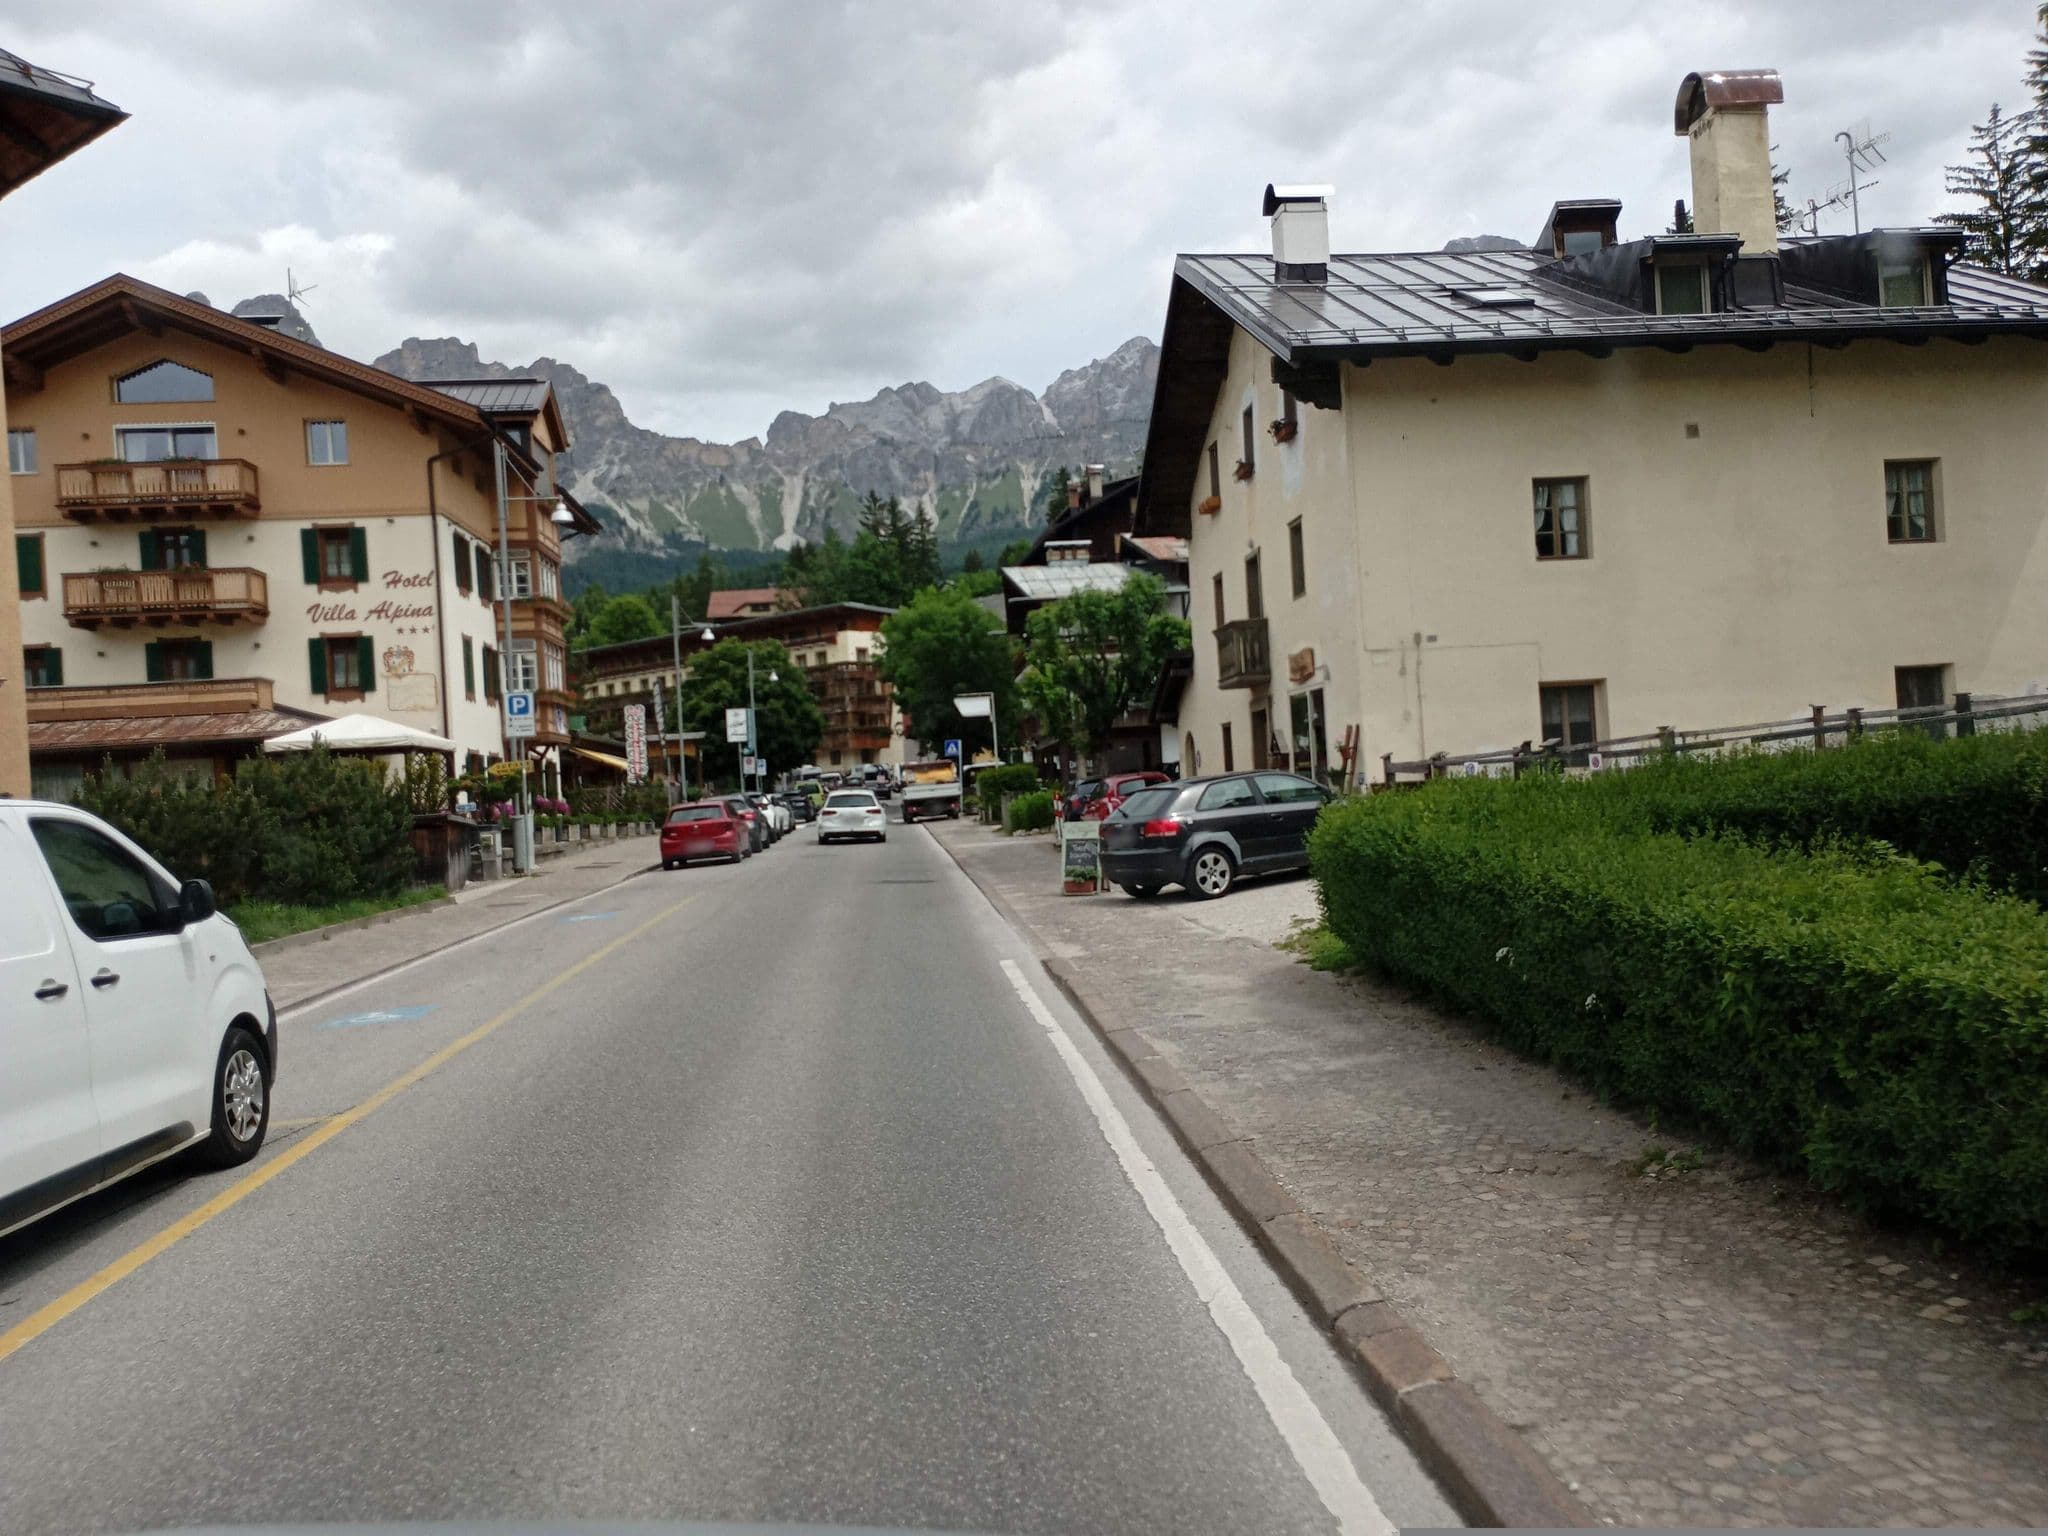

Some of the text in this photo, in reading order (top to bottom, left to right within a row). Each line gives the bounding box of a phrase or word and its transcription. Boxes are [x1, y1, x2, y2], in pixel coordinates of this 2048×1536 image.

[383, 570, 434, 589] Hotel
[307, 601, 433, 623] Villa Alpina
[512, 697, 526, 713] P
